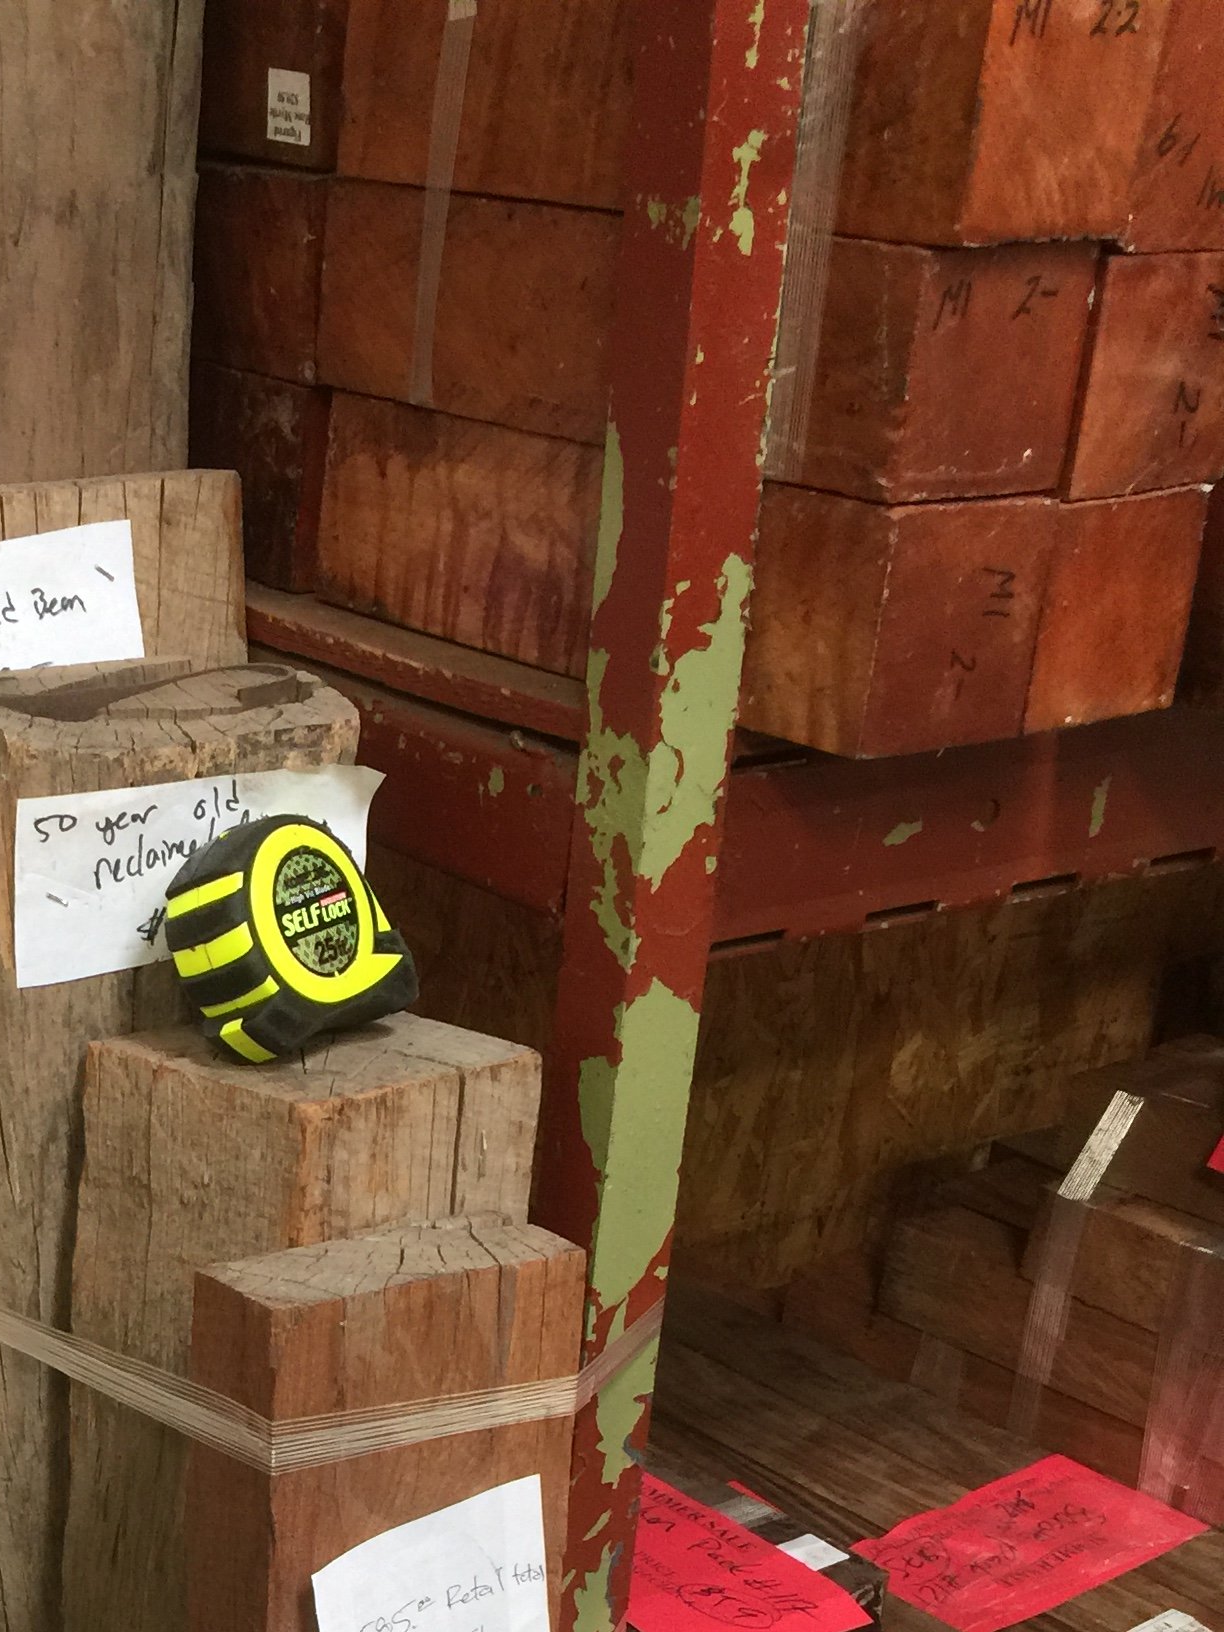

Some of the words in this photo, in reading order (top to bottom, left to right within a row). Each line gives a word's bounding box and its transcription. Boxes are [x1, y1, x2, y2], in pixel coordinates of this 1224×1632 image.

[34, 814, 77, 842] 50
[95, 805, 158, 845] year
[193, 779, 241, 820] old
[281, 903, 320, 937] SELF
[321, 899, 351, 922] LOCK
